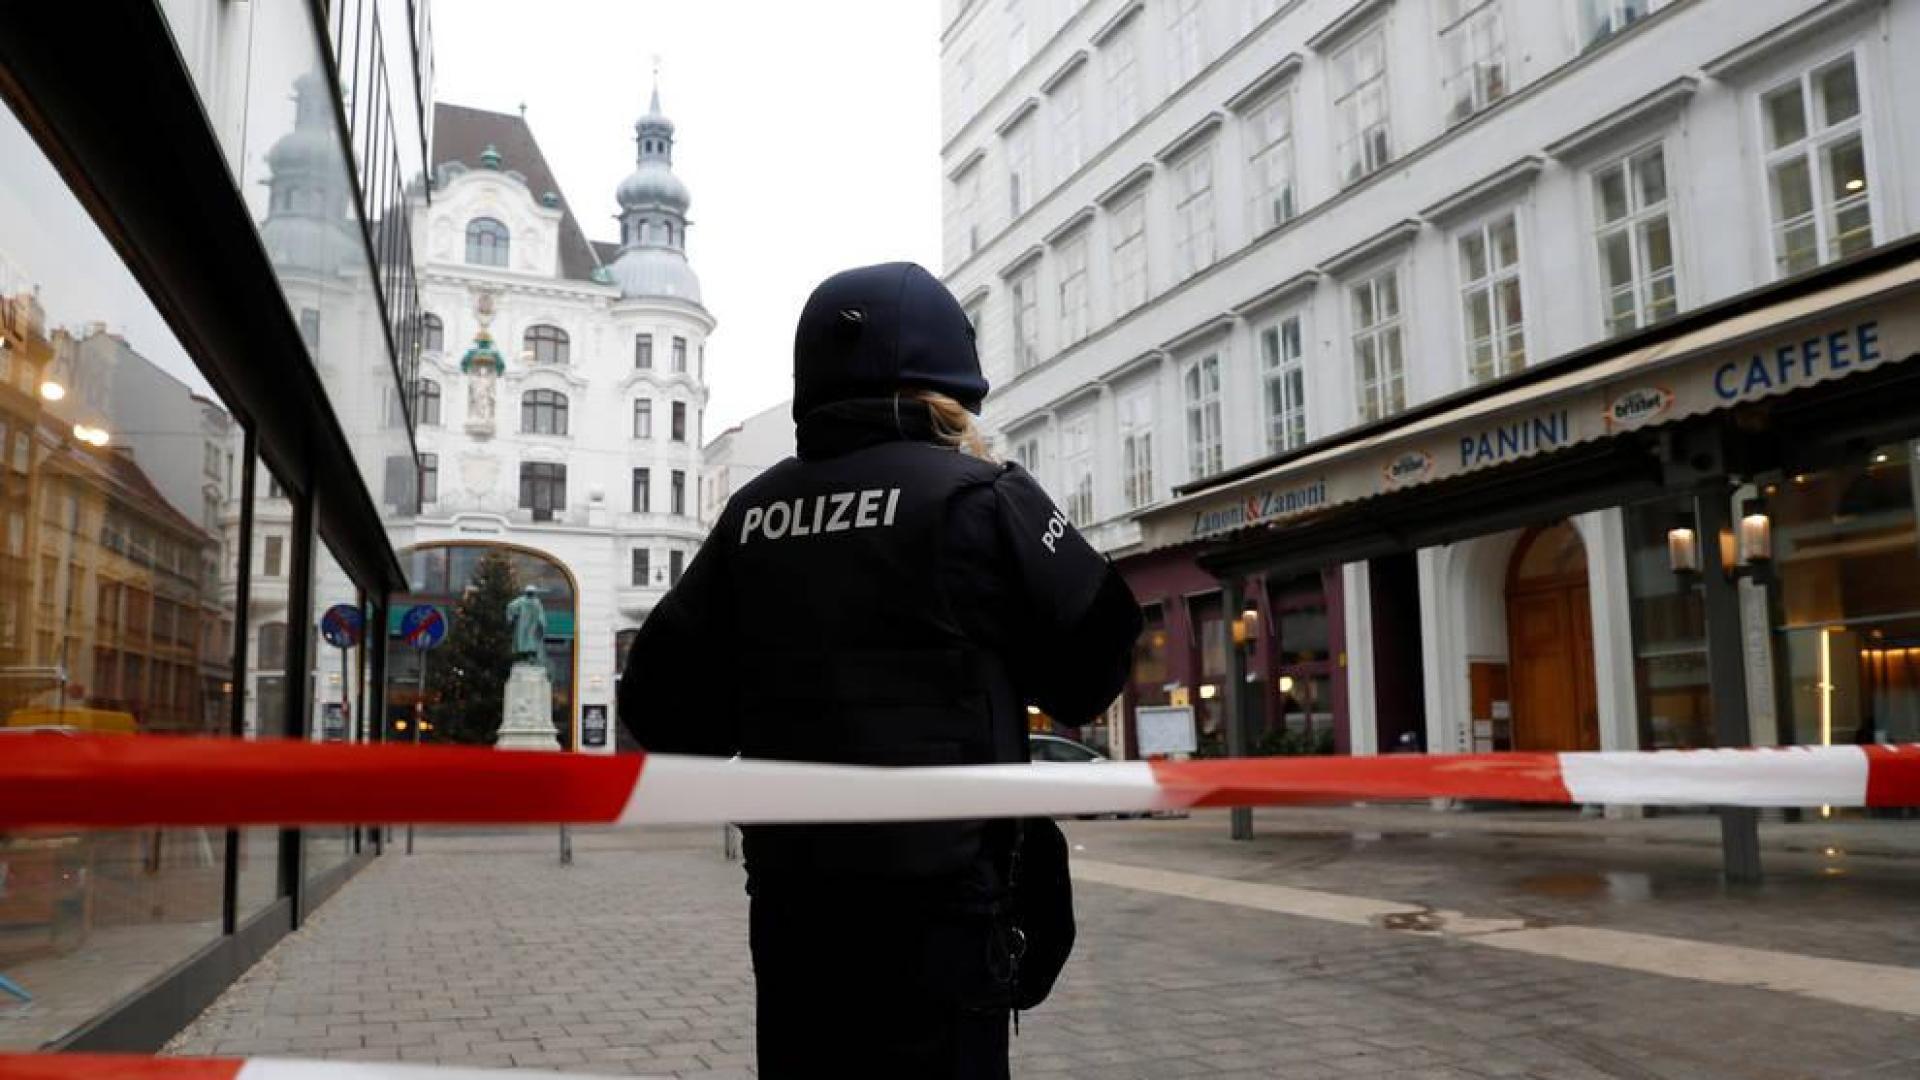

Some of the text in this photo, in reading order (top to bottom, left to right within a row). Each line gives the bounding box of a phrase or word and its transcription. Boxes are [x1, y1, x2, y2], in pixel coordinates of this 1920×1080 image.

[1714, 320, 1880, 399] CAFFEE
[1460, 409, 1568, 467] PANINI
[740, 487, 901, 545] POLIZEI
